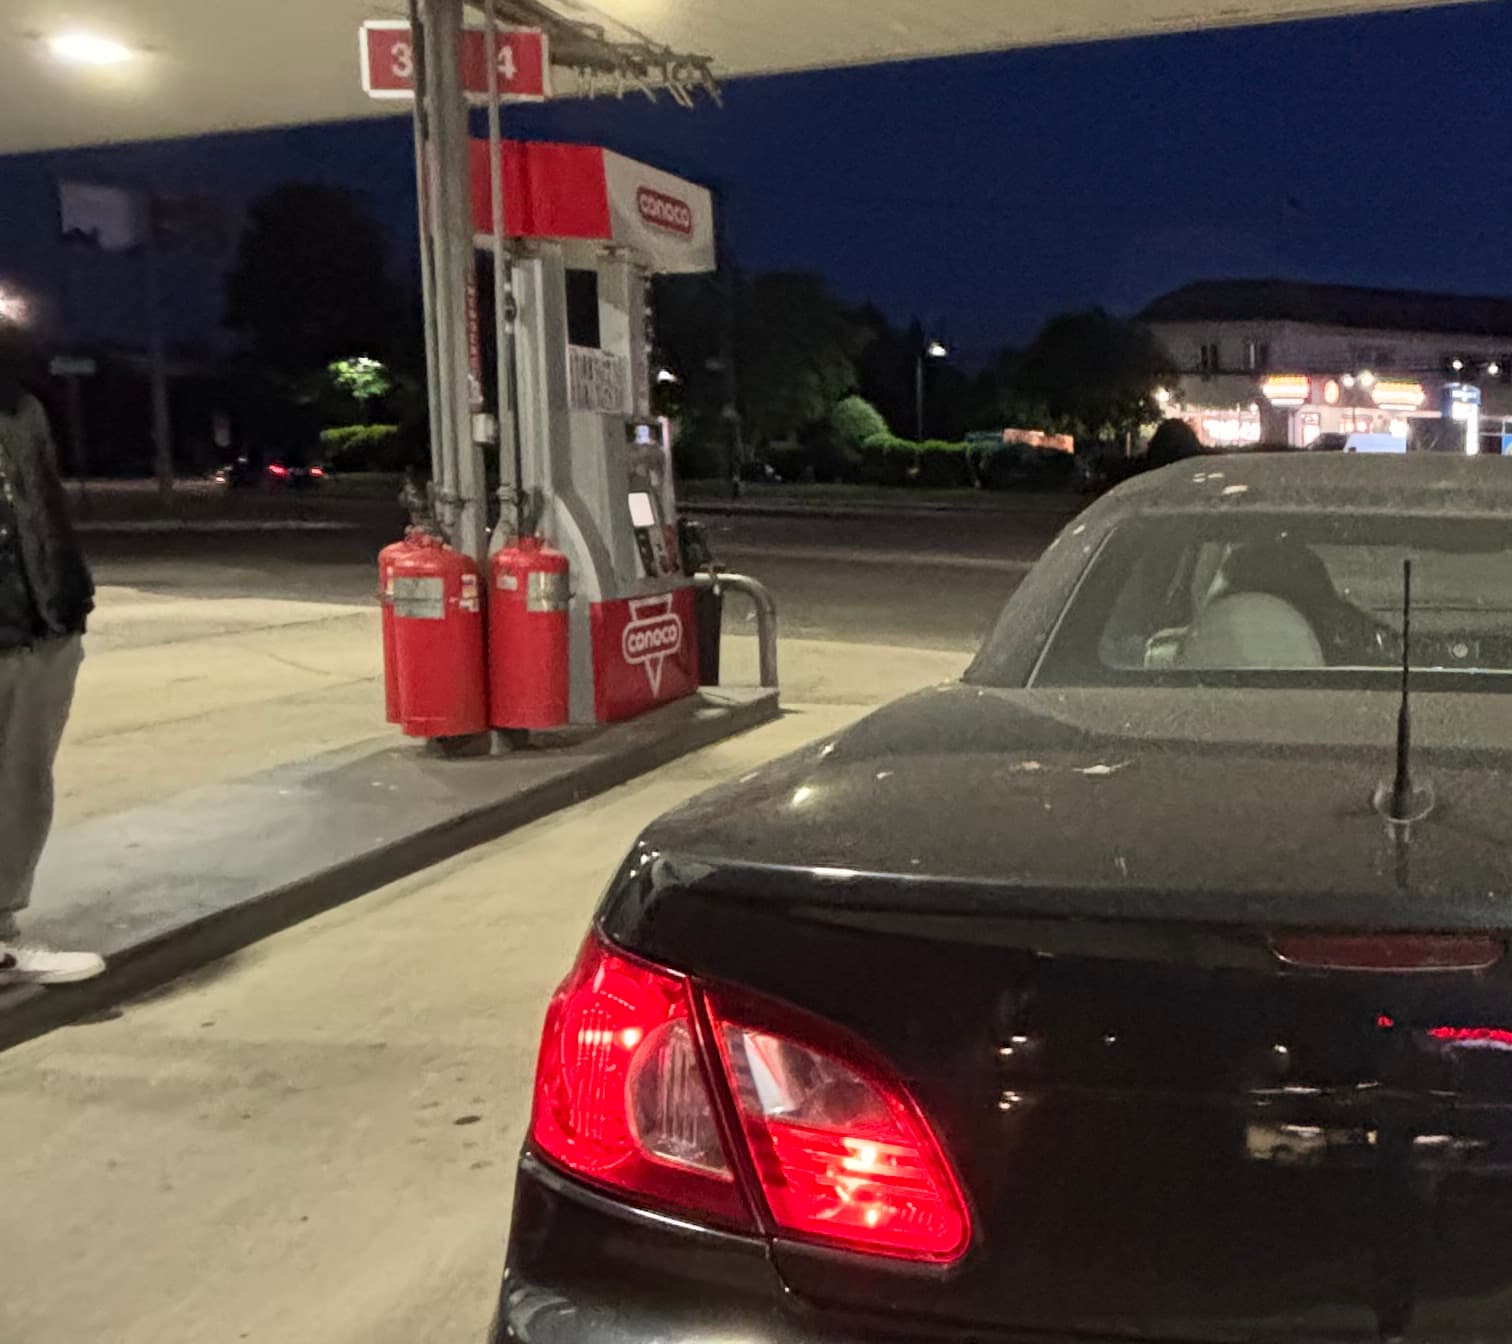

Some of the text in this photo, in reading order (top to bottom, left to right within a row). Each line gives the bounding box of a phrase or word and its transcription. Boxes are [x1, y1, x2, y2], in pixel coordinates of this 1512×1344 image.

[391, 42, 413, 77] 3
[498, 45, 517, 80] 4
[627, 623, 678, 653] conoco
